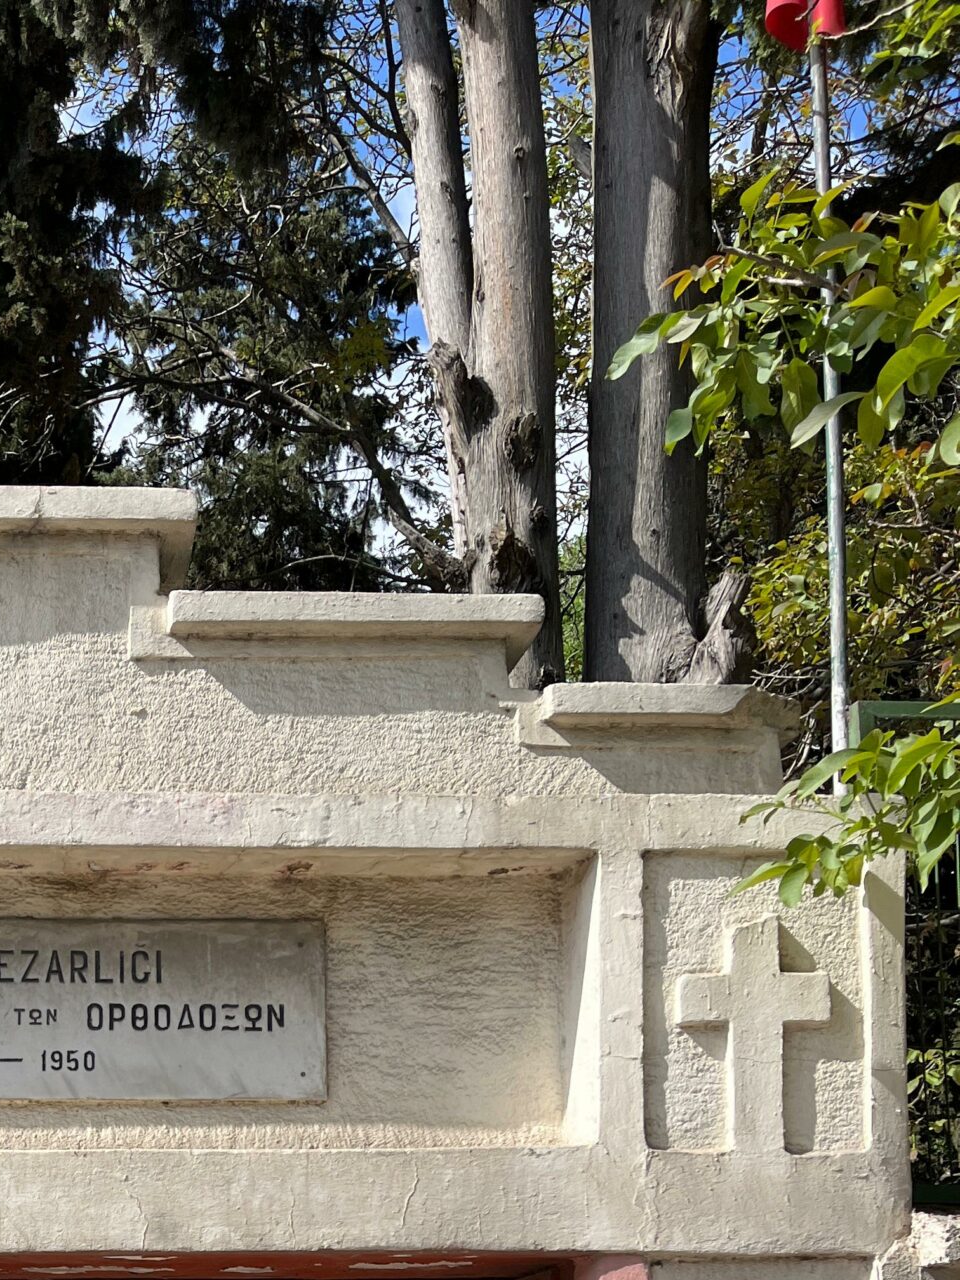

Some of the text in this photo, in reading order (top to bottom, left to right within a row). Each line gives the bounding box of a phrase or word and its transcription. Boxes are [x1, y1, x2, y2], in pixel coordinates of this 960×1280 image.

[13, 1007, 58, 1026] ΤΩΝ
[86, 1002, 285, 1032] ΟΡΘΟΔΟΞΩΝ
[41, 1049, 96, 1072] 1950
